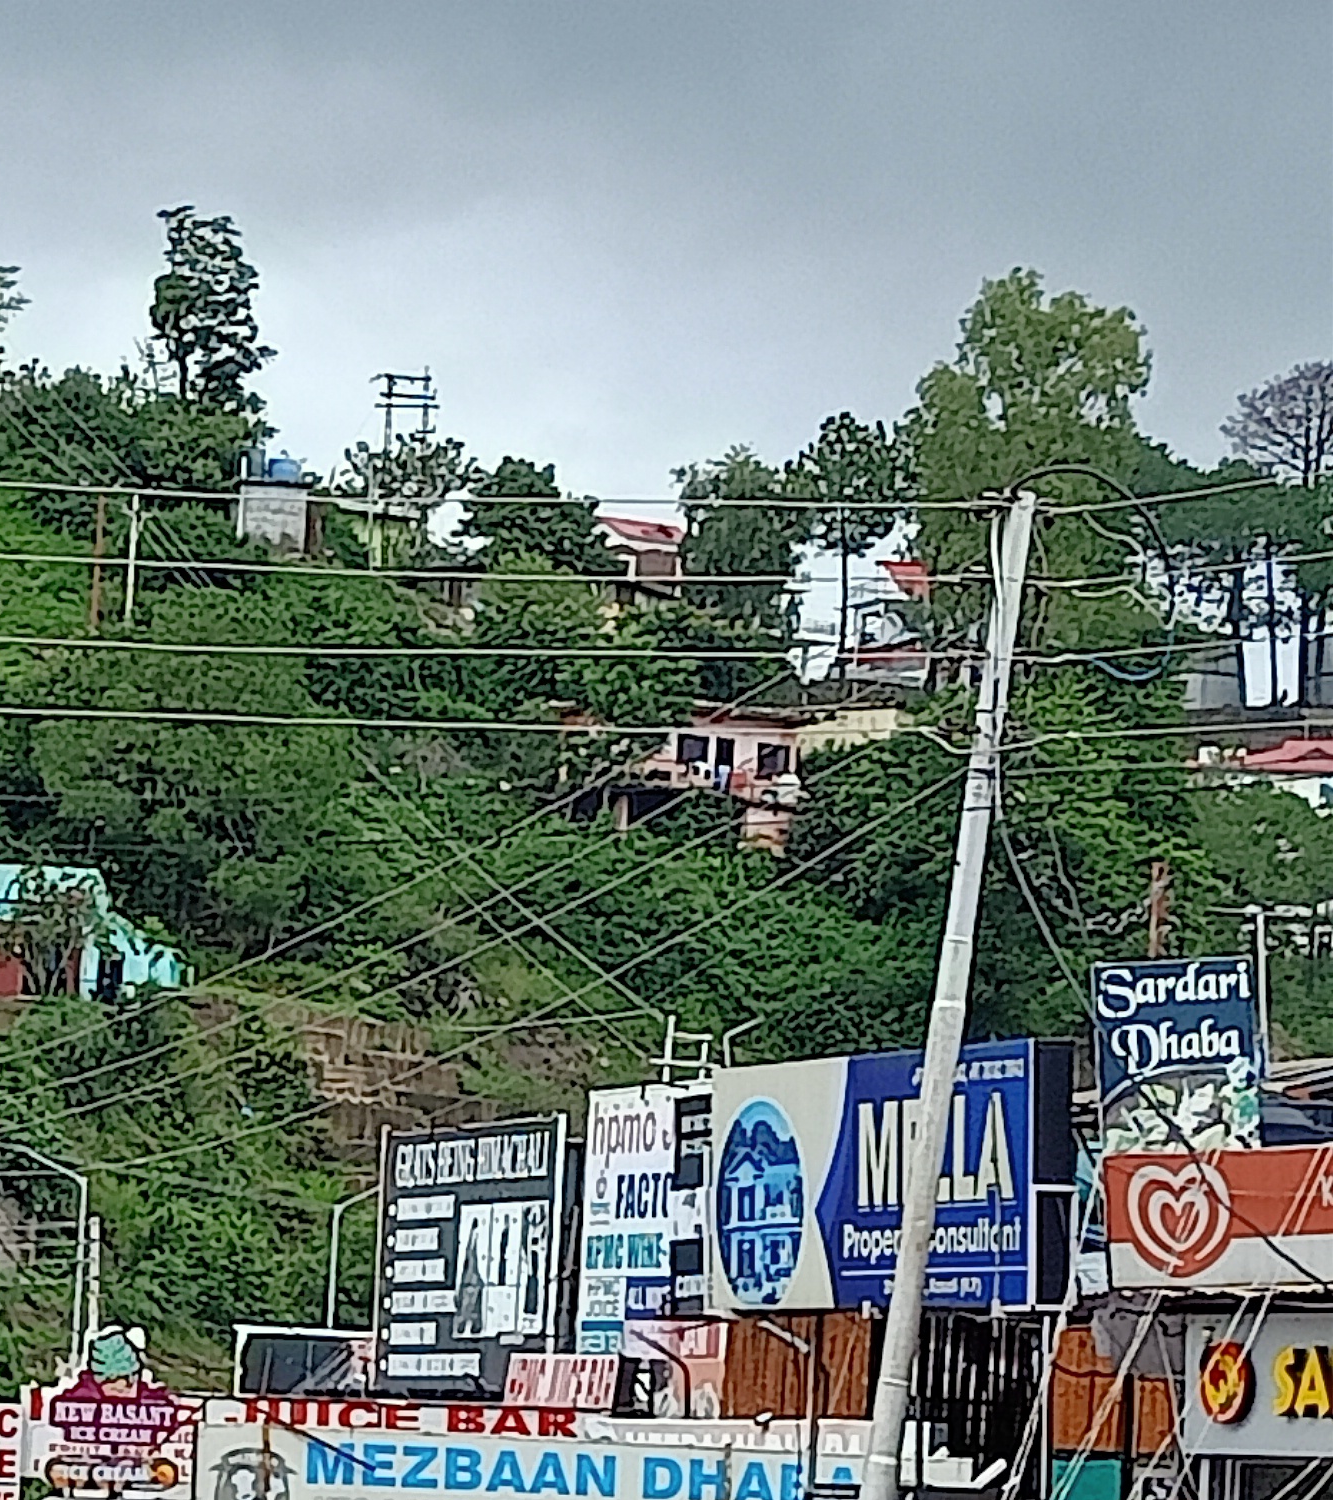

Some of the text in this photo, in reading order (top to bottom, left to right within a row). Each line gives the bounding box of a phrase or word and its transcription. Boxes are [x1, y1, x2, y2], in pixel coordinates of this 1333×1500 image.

[1098, 962, 1251, 1018] Sardari
[1111, 1018, 1240, 1077] Dhaba
[858, 1092, 1014, 1207] MLA
[929, 1216, 1022, 1254] onsultant
[54, 1402, 175, 1427] NEW BASANT
[447, 1405, 576, 1438] BAR
[305, 1442, 616, 1498] MEZBAAN
